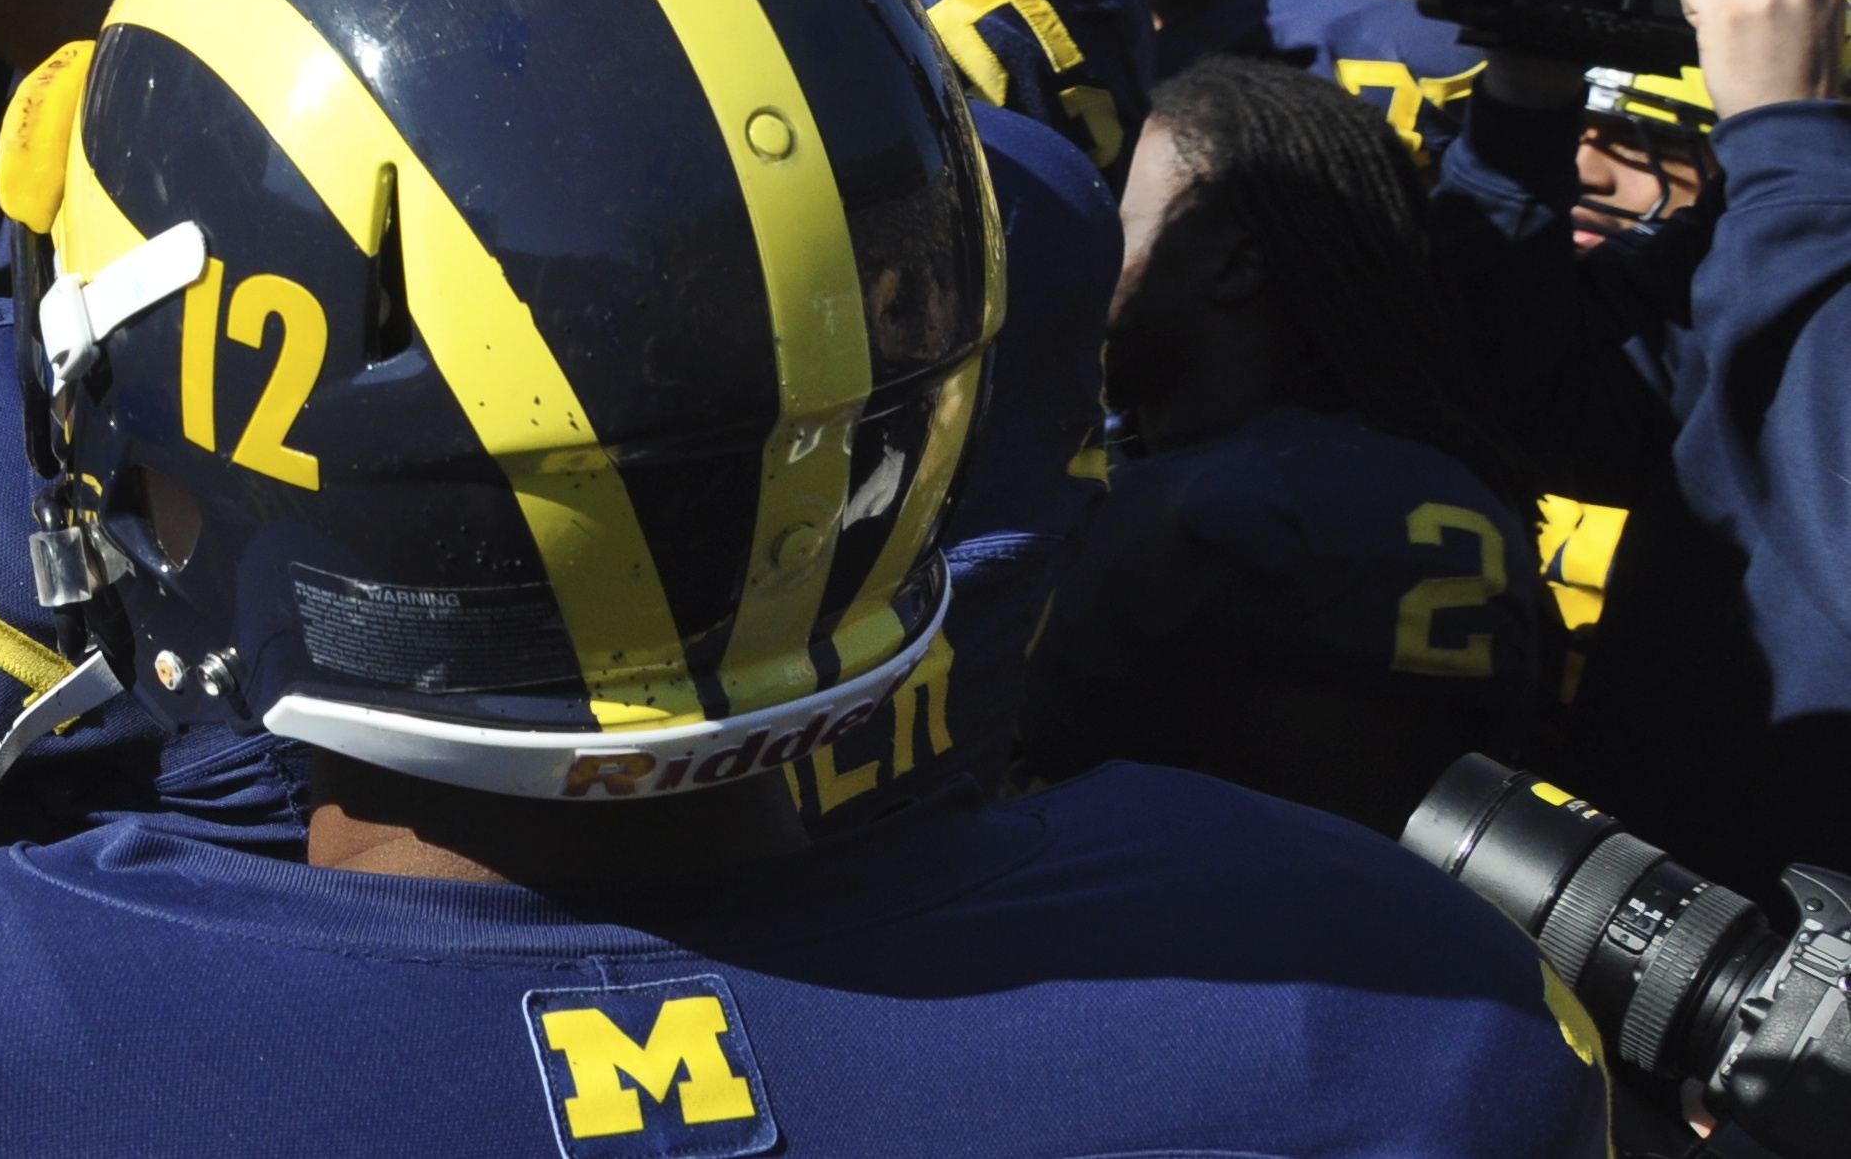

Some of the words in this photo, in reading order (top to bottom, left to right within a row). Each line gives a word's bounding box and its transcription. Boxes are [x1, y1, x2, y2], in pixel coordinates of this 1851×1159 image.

[181, 256, 329, 492] 12
[367, 589, 460, 607] WARNING
[1391, 503, 1506, 676] 2
[542, 996, 756, 1140] M
